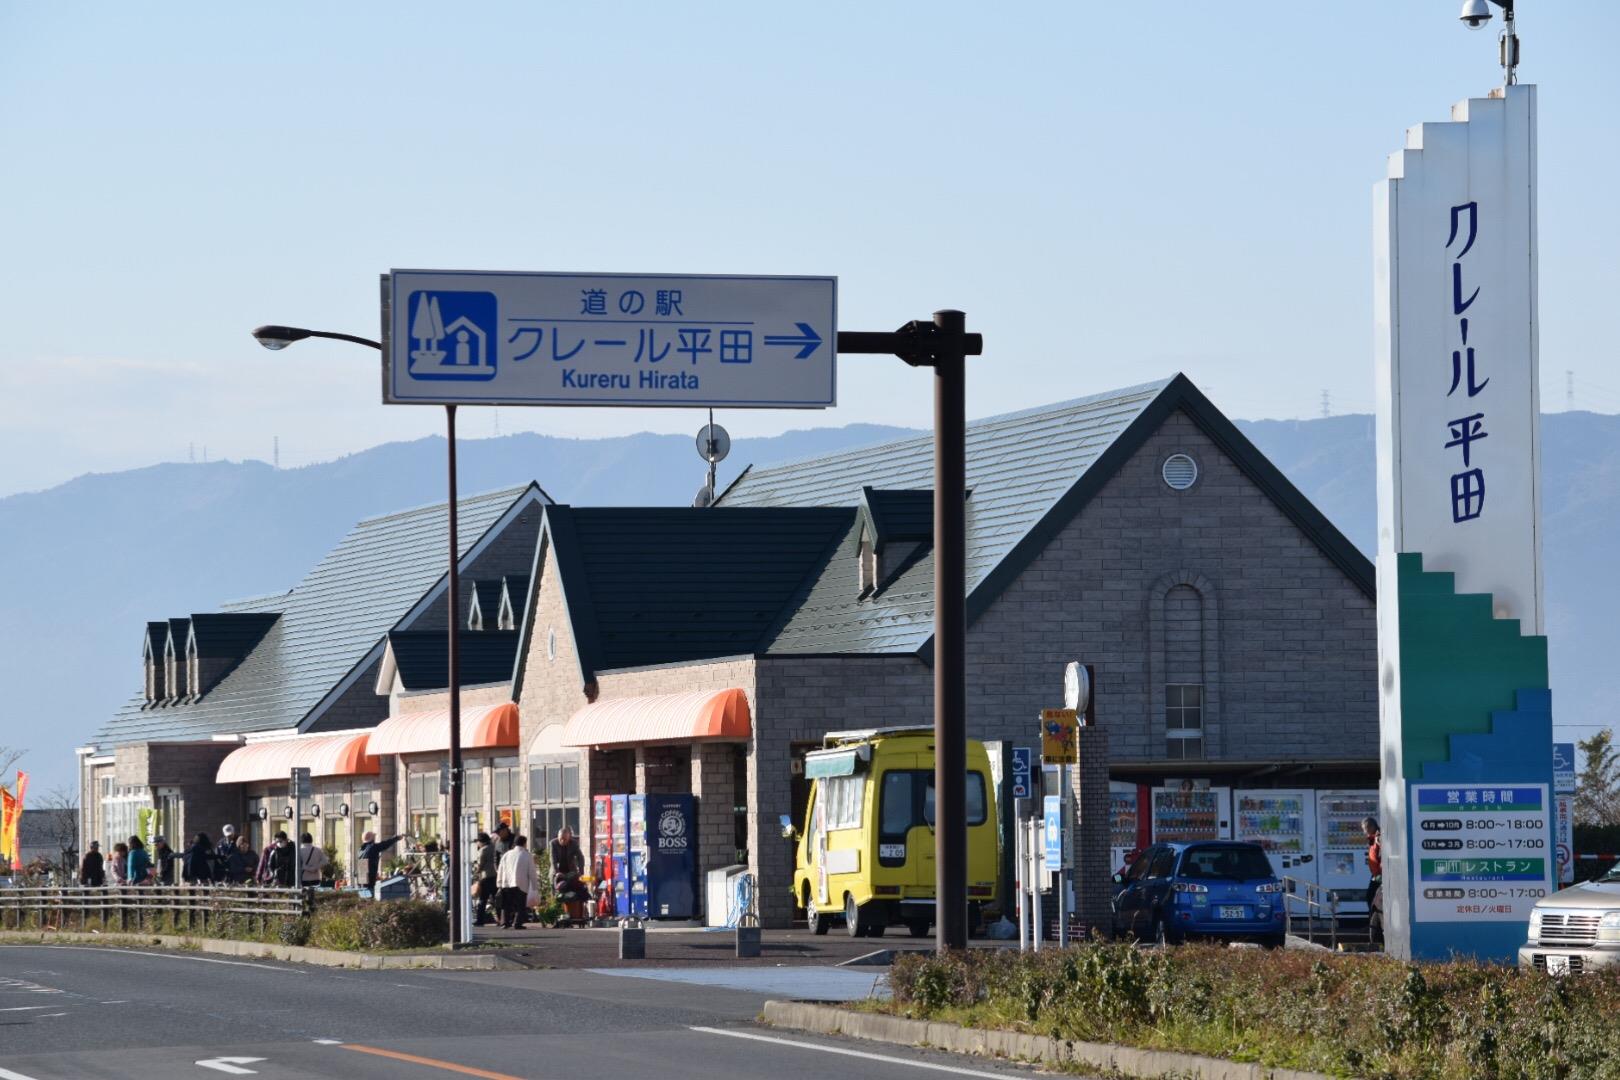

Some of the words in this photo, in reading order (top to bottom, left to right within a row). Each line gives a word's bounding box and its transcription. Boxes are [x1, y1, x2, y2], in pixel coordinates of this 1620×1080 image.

[581, 288, 683, 317] 道の駅
[508, 326, 754, 365] クレール平田
[1445, 201, 1490, 523] クレール平田
[561, 368, 631, 389] Kureru
[639, 369, 700, 391] Hirata
[1447, 790, 1514, 804] 営業時間
[1422, 821, 1436, 830] 4月
[1445, 821, 1460, 830] 10月
[658, 837, 687, 848] BOSS
[1466, 860, 1532, 873] レストラン
